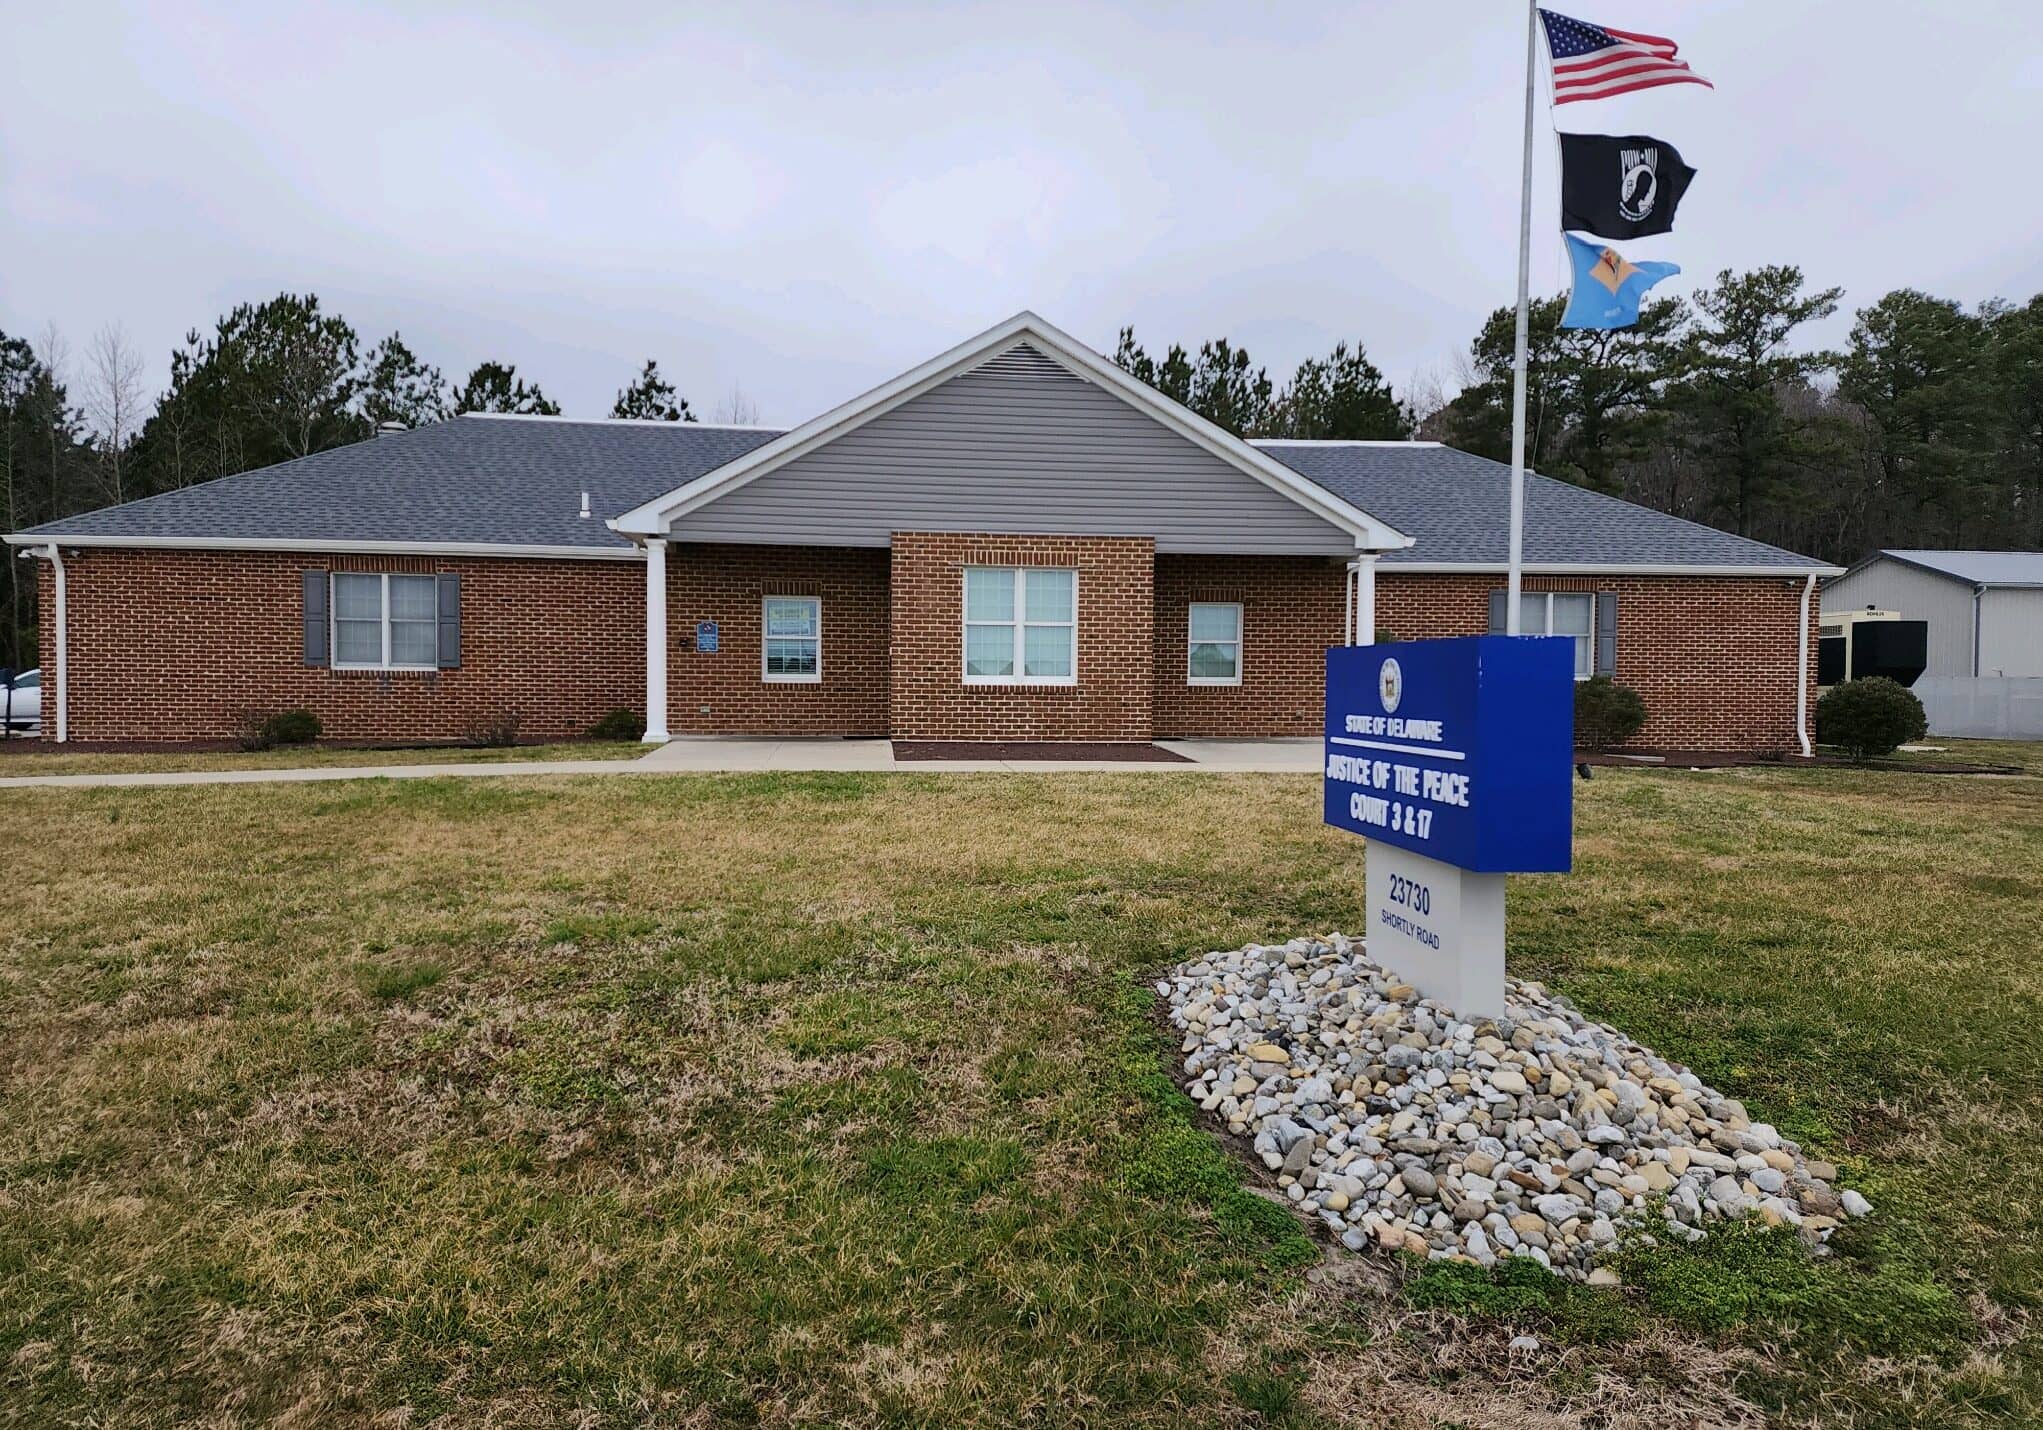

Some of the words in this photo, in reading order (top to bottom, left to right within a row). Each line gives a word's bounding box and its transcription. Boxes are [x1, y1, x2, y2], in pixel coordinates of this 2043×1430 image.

[1345, 715, 1373, 734] STATE
[1373, 717, 1386, 735] OF
[1387, 718, 1443, 742] DELAWARE
[1327, 754, 1371, 786] JUSTICE
[1372, 760, 1391, 789] OF
[1393, 764, 1420, 796] THE
[1423, 769, 1470, 807] PEACE
[1350, 792, 1389, 827] COURT
[1391, 802, 1402, 831] 3
[1404, 805, 1416, 835] &
[1417, 808, 1433, 839] 17
[1390, 873, 1430, 916] 23730
[1381, 909, 1416, 938] SHORTLY
[1416, 926, 1440, 950] ROAD
